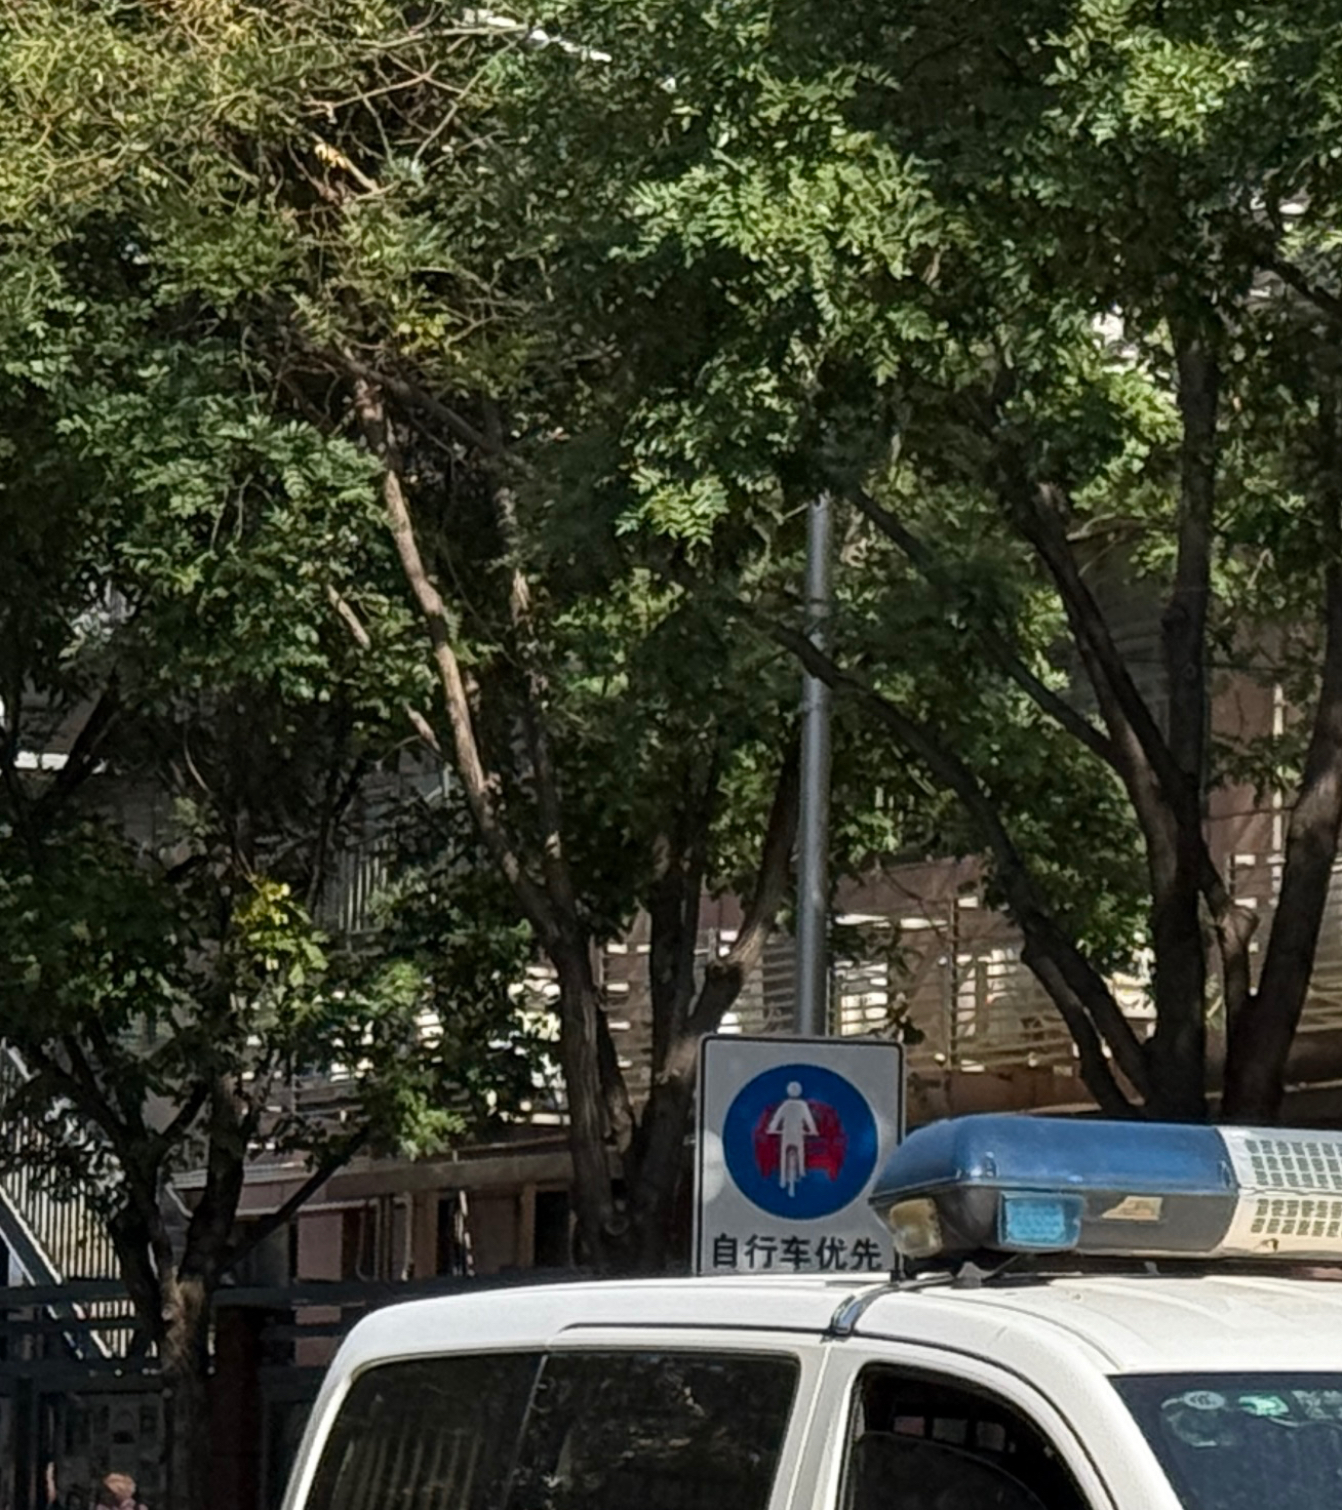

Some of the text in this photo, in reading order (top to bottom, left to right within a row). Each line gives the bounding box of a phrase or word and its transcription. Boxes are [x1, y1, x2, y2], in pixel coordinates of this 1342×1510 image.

[713, 1232, 882, 1270] 自行车优先
